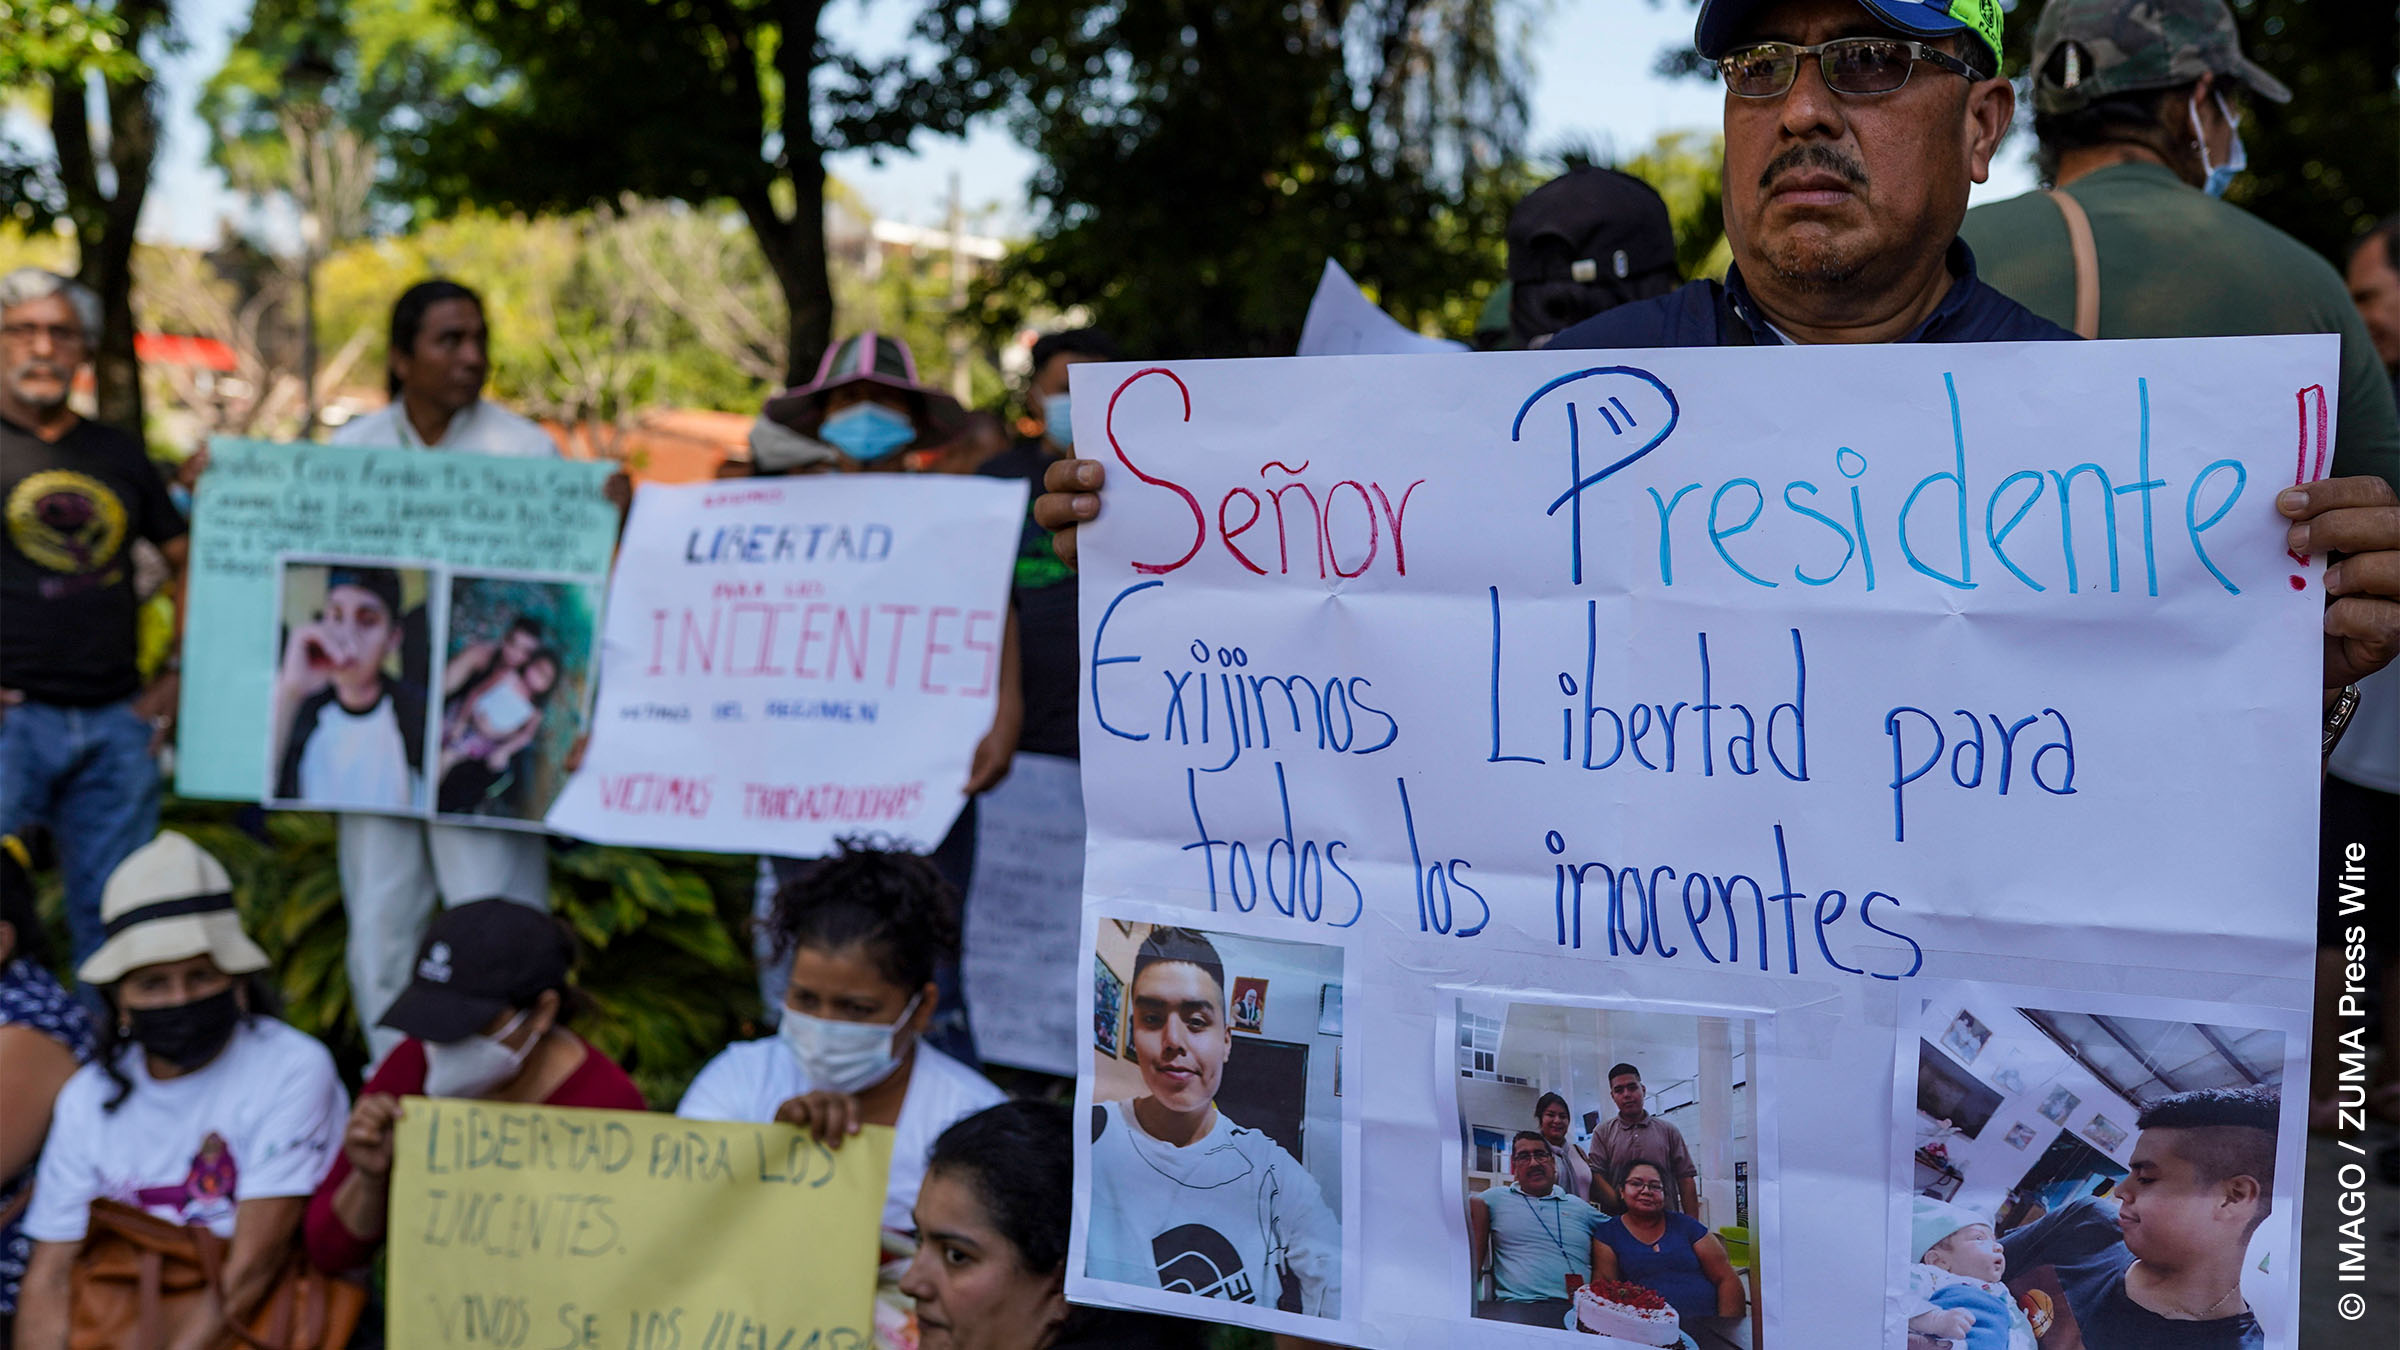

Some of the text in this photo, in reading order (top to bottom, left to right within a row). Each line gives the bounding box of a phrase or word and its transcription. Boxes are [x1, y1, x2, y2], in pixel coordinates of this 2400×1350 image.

[685, 523, 893, 566] LIBERTAD
[1105, 368, 1425, 579] Señor
[646, 604, 997, 697] INOCENTES
[1487, 585, 1810, 781] Libertad
[1885, 706, 2077, 842] para
[1182, 761, 1362, 927] todos
[1398, 777, 1490, 937] los
[1545, 820, 1922, 980] inocentes
[648, 1131, 735, 1183] PARA
[755, 1131, 836, 1189] LOS
